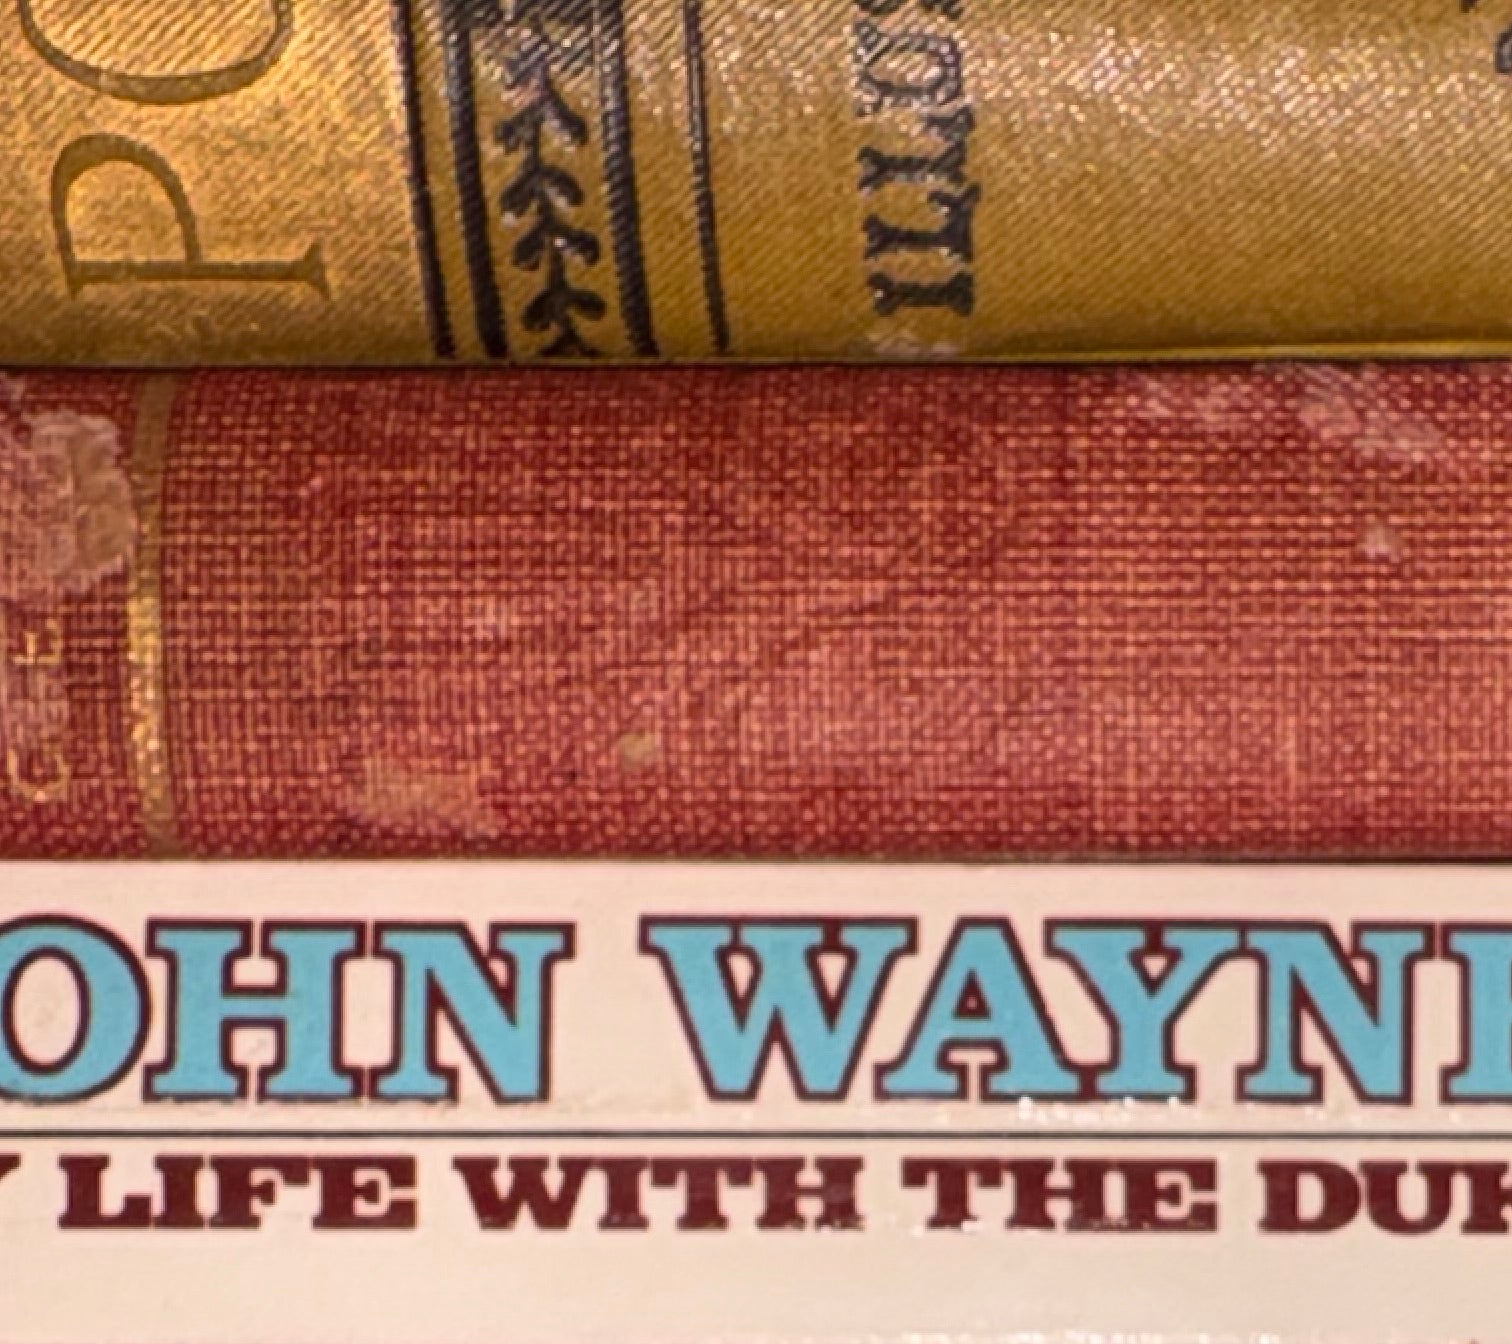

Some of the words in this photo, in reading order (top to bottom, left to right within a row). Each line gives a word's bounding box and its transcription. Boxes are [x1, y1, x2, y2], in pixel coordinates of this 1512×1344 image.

[855, 0, 982, 318] ILLU
[0, 914, 578, 1105] OHN
[57, 1154, 418, 1230] LIFE
[452, 1155, 865, 1231] WITH
[901, 1157, 1219, 1232] THE
